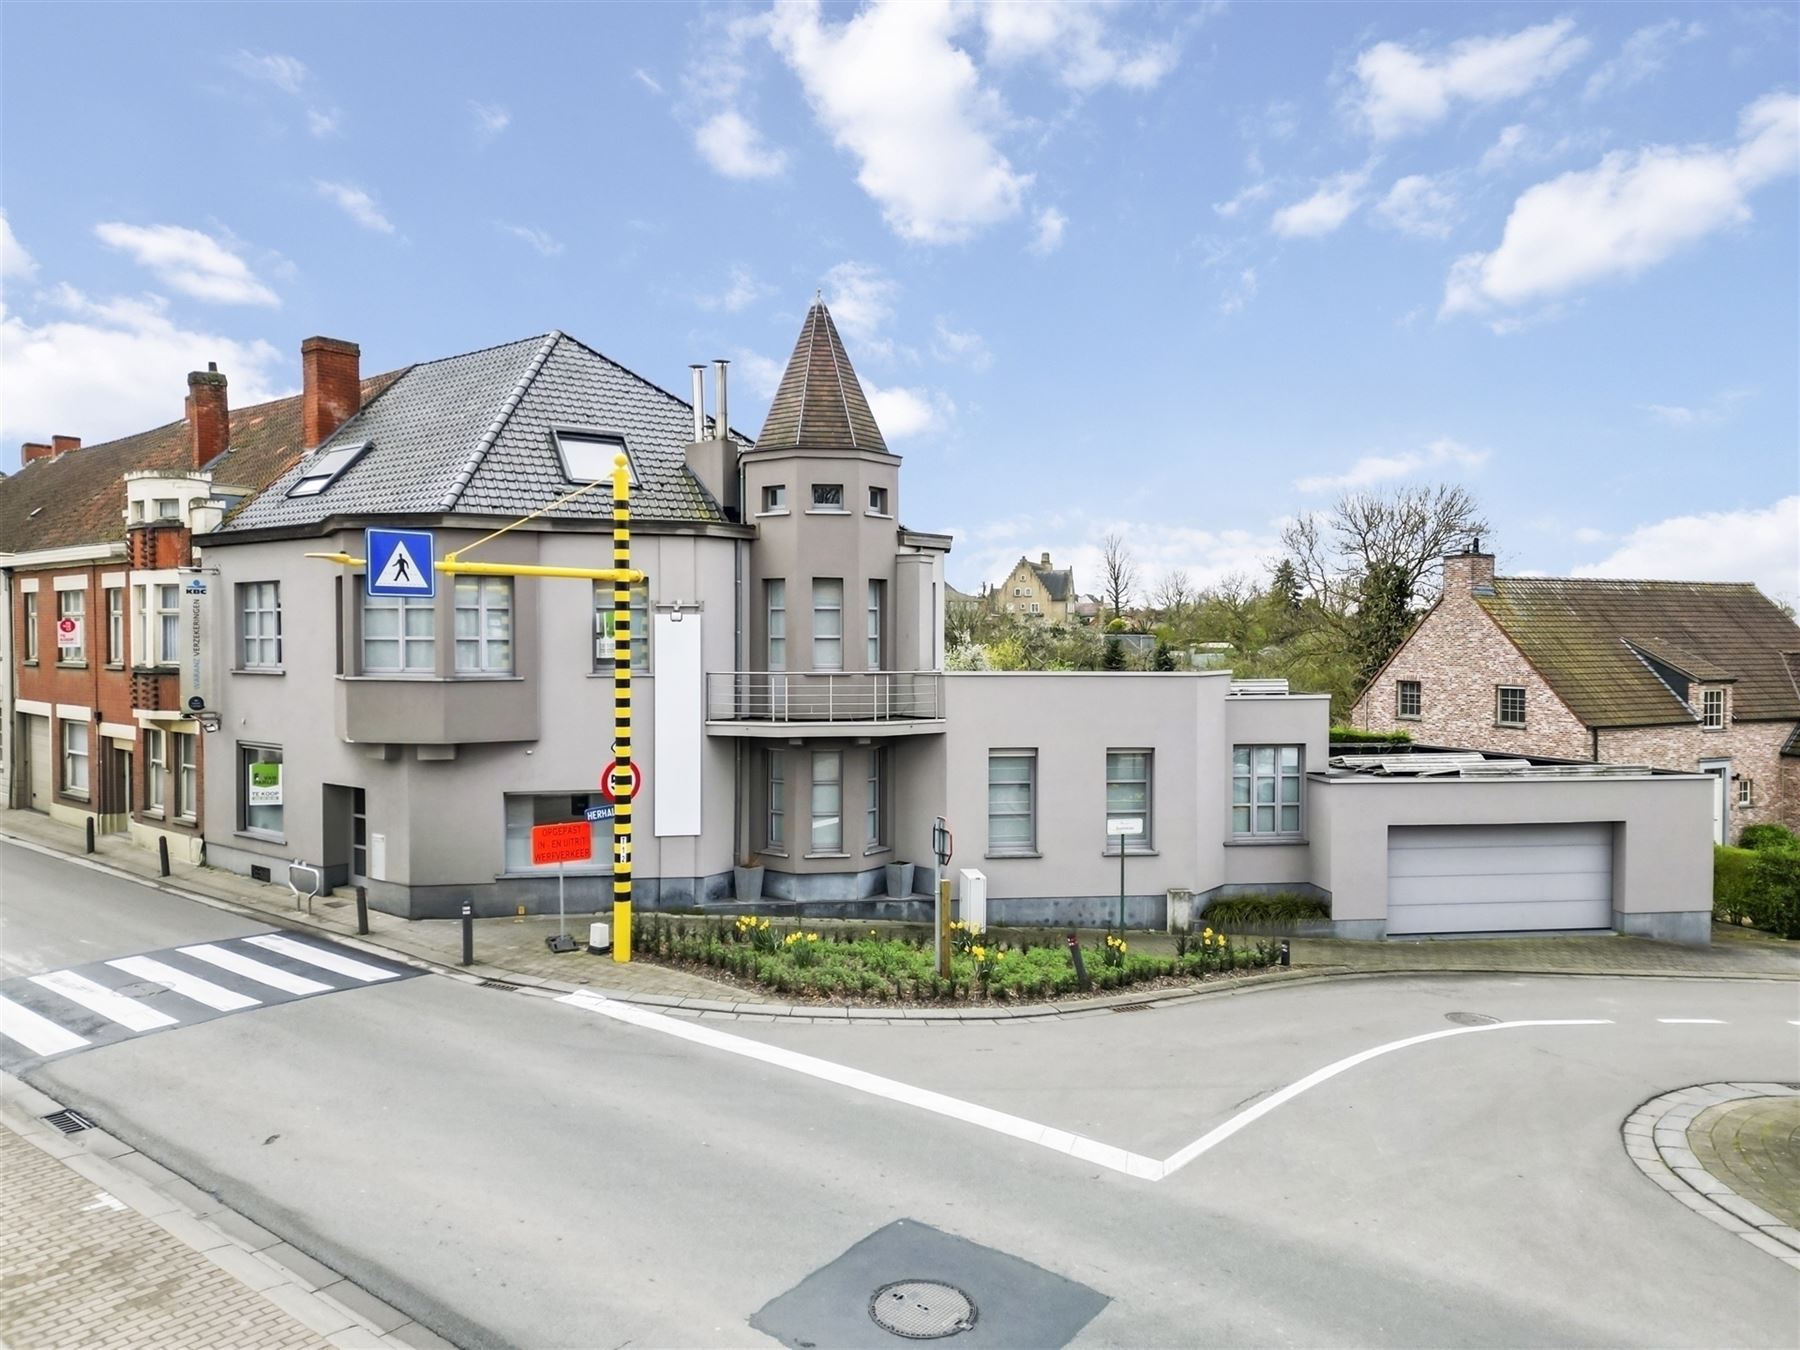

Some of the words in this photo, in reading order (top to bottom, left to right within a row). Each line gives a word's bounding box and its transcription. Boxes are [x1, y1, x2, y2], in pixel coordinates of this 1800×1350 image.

[587, 808, 615, 820] HERHAL
[542, 826, 581, 837] OPGEPAST
[552, 840, 561, 848] EN
[535, 849, 590, 861] WERFVERKEER
